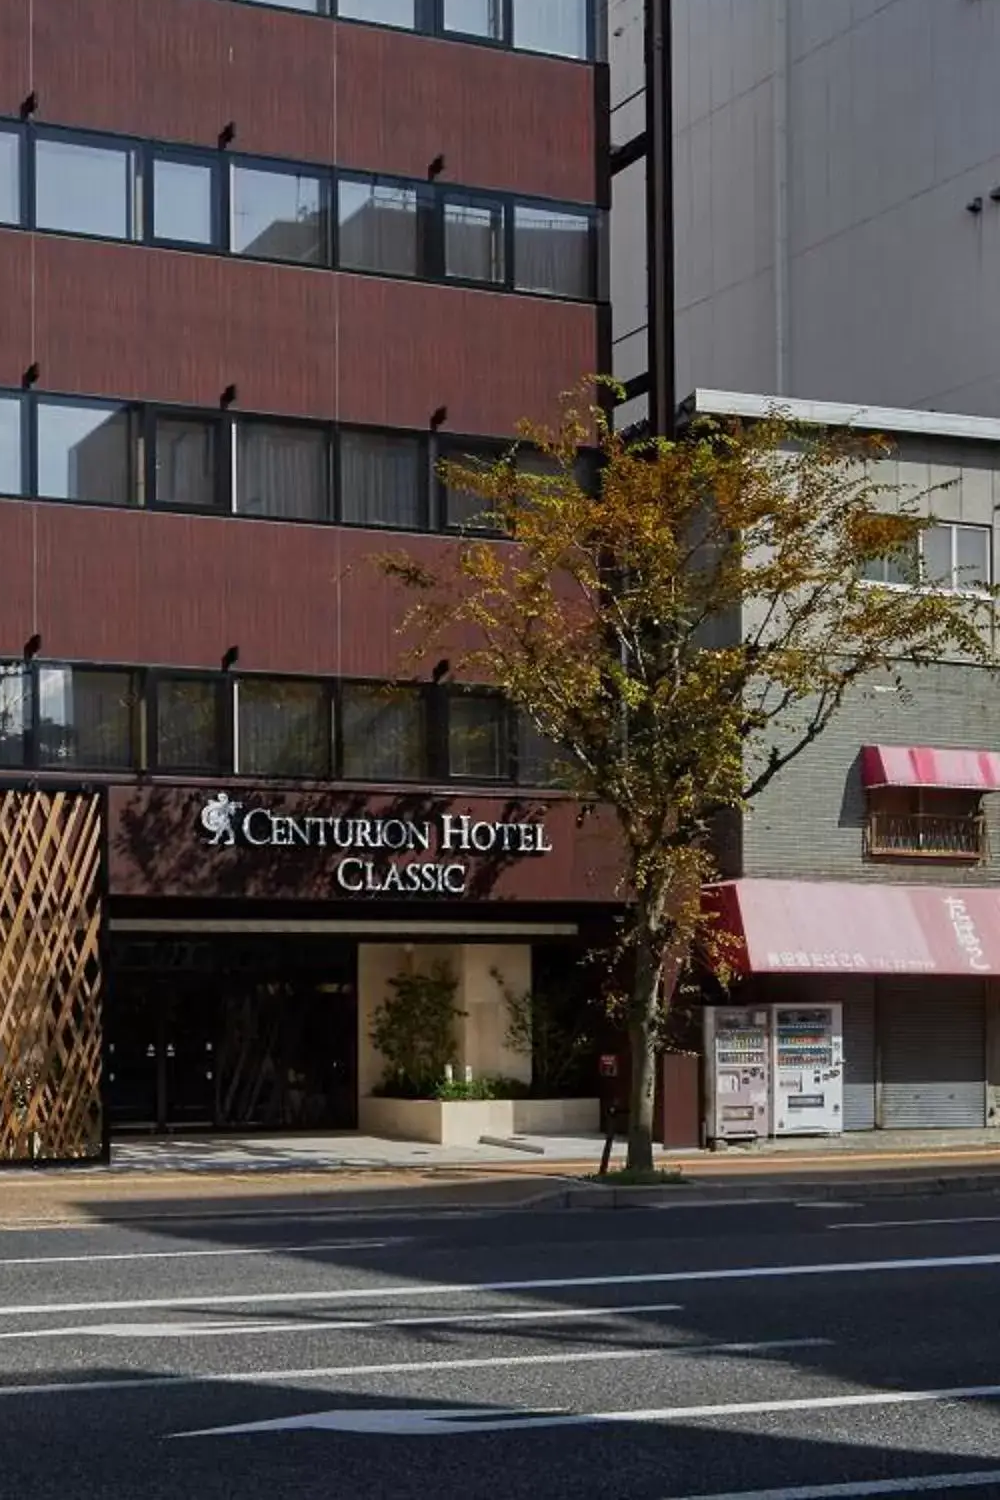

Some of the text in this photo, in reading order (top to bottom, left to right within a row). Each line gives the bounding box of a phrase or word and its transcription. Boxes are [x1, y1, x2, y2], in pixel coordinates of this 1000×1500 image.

[241, 808, 553, 852] CENTURION HOTEL
[336, 857, 466, 894] CLASSIC
[941, 895, 992, 970] たばこ
